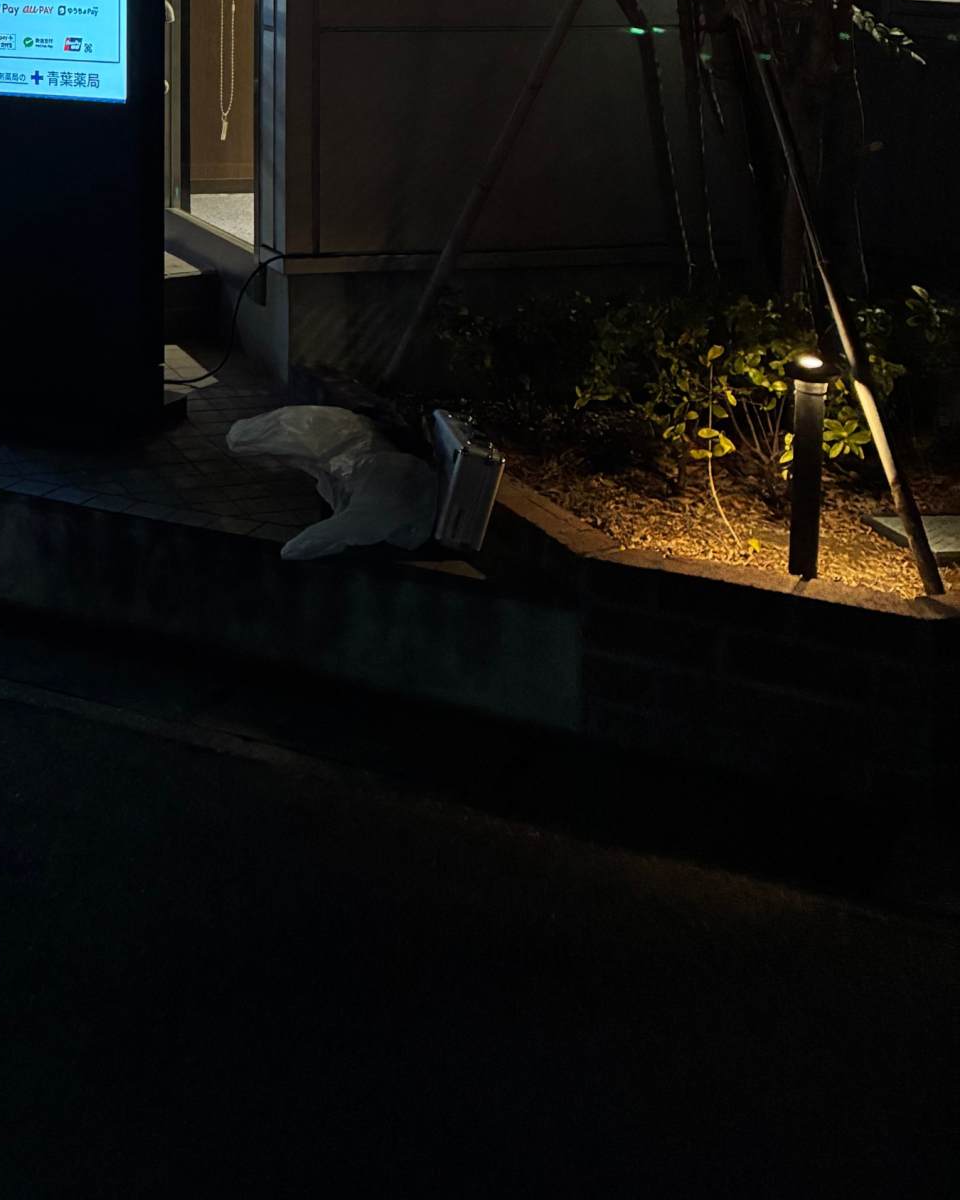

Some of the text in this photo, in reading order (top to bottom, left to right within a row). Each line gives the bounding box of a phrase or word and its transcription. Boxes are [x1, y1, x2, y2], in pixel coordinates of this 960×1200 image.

[2, 3, 20, 16] Pay
[22, 5, 54, 15] au PAY
[47, 71, 100, 89] 青葉薬局
